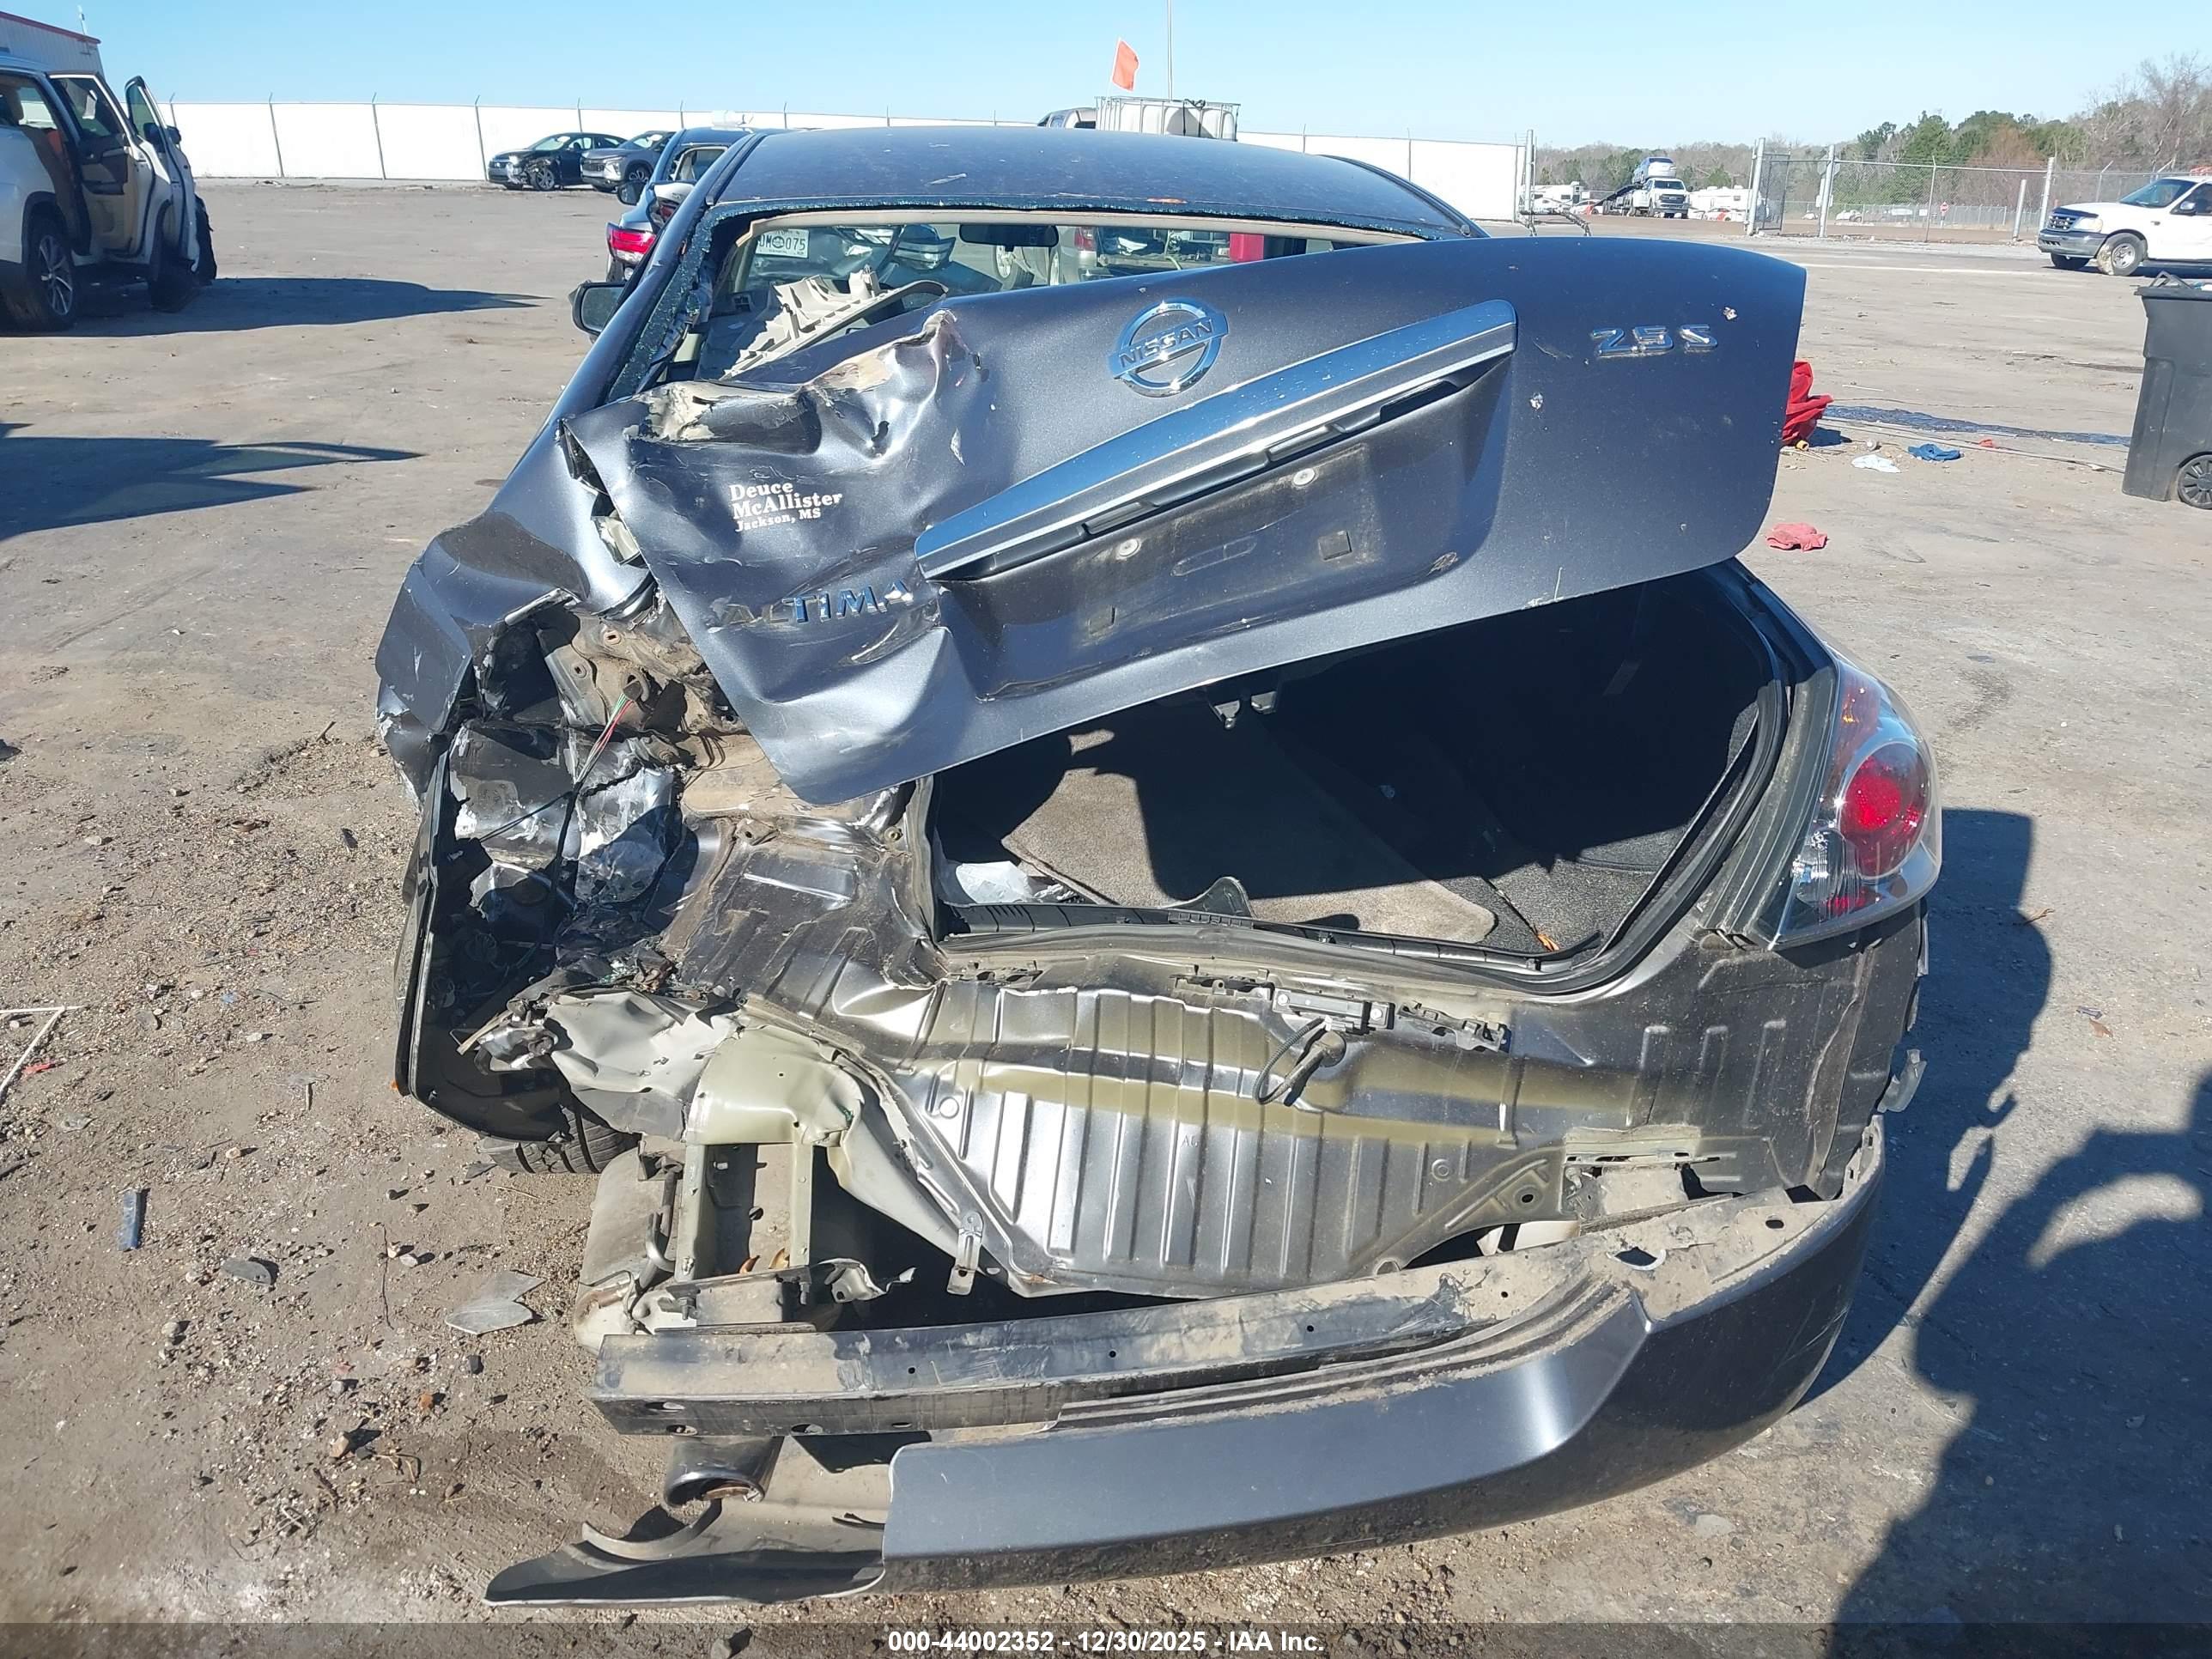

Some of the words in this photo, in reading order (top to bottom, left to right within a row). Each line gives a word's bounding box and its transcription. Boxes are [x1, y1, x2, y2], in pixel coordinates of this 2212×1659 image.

[785, 237, 806, 251] 075
[1119, 319, 1212, 368] NISSAN
[1679, 324, 1717, 354] S
[730, 482, 794, 501] Deuce
[732, 492, 843, 520] McAllister
[735, 514, 796, 532] Jackson,
[799, 507, 821, 520] MS
